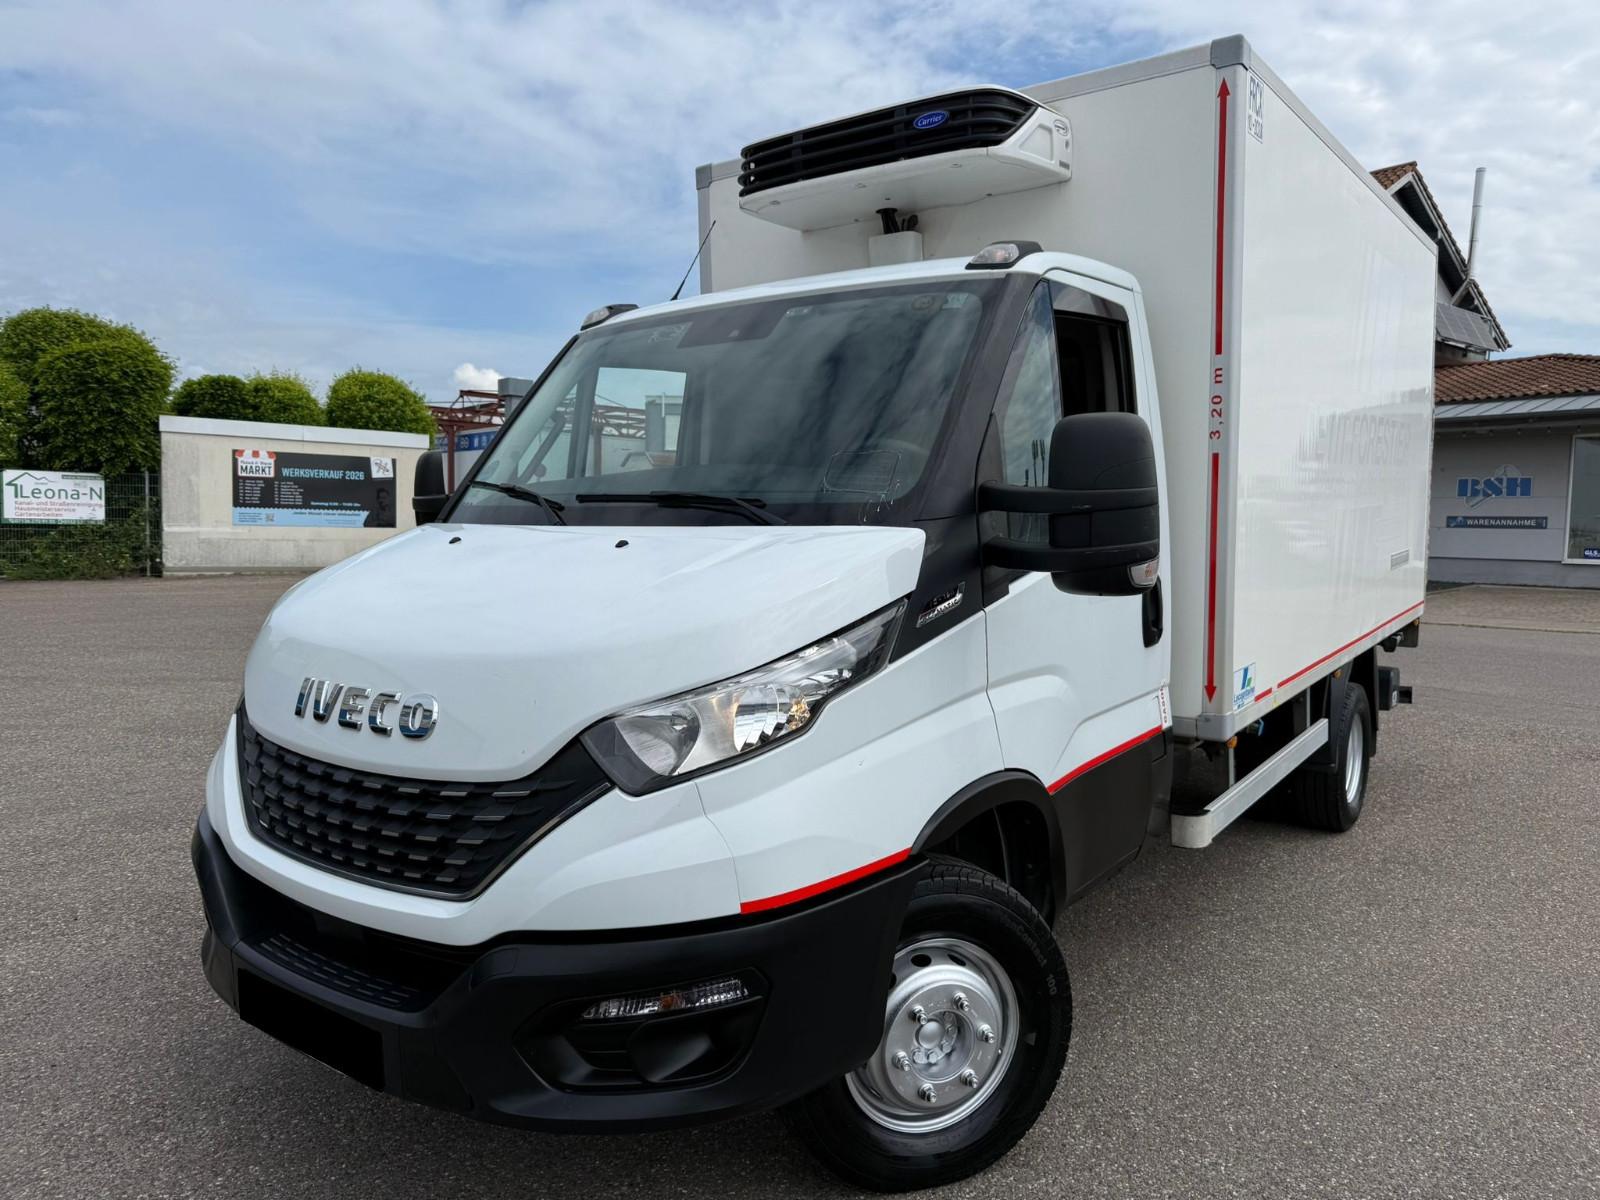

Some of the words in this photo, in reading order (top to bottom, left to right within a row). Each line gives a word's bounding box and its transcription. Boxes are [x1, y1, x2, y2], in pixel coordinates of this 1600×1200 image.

[917, 113, 943, 127] Carrier
[1214, 367, 1223, 384] m
[1209, 394, 1224, 440] 3,20
[240, 465, 273, 476] MARKT
[281, 467, 344, 480] WERKSVERKAUF
[345, 470, 365, 481] 2026
[20, 484, 103, 501] Leona-N
[1457, 477, 1532, 497] BSH
[1466, 518, 1537, 527] WARENANNAHME
[294, 676, 440, 742] IVECO
[1045, 973, 1057, 996] 100
